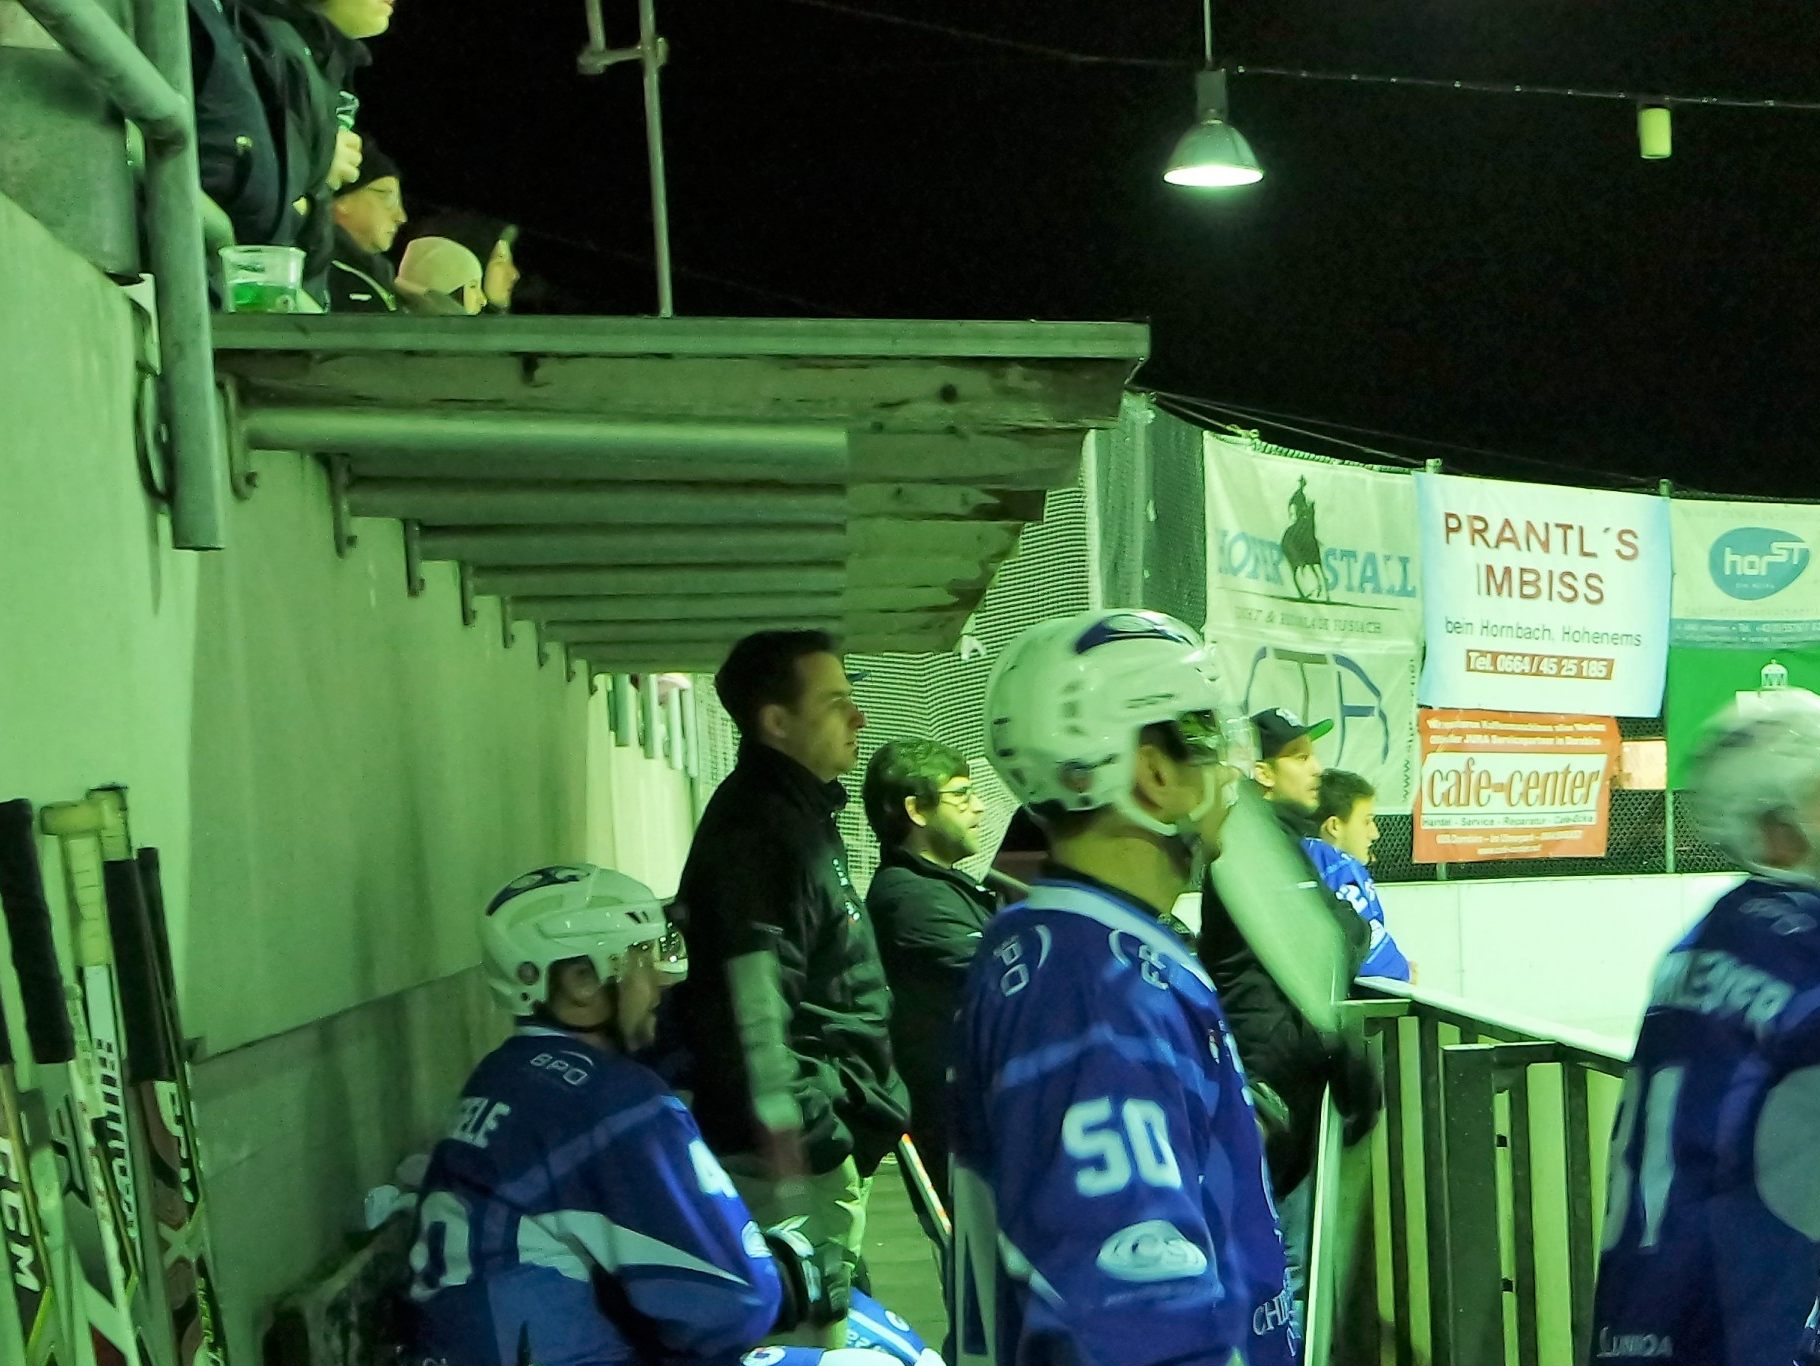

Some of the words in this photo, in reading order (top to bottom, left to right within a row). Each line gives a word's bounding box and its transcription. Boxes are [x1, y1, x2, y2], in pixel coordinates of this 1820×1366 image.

[1475, 562, 1605, 606] IMBISS
[1562, 626, 1642, 647] Hohenems
[1428, 756, 1601, 808] cafe-center
[1062, 1096, 1181, 1198] 50
